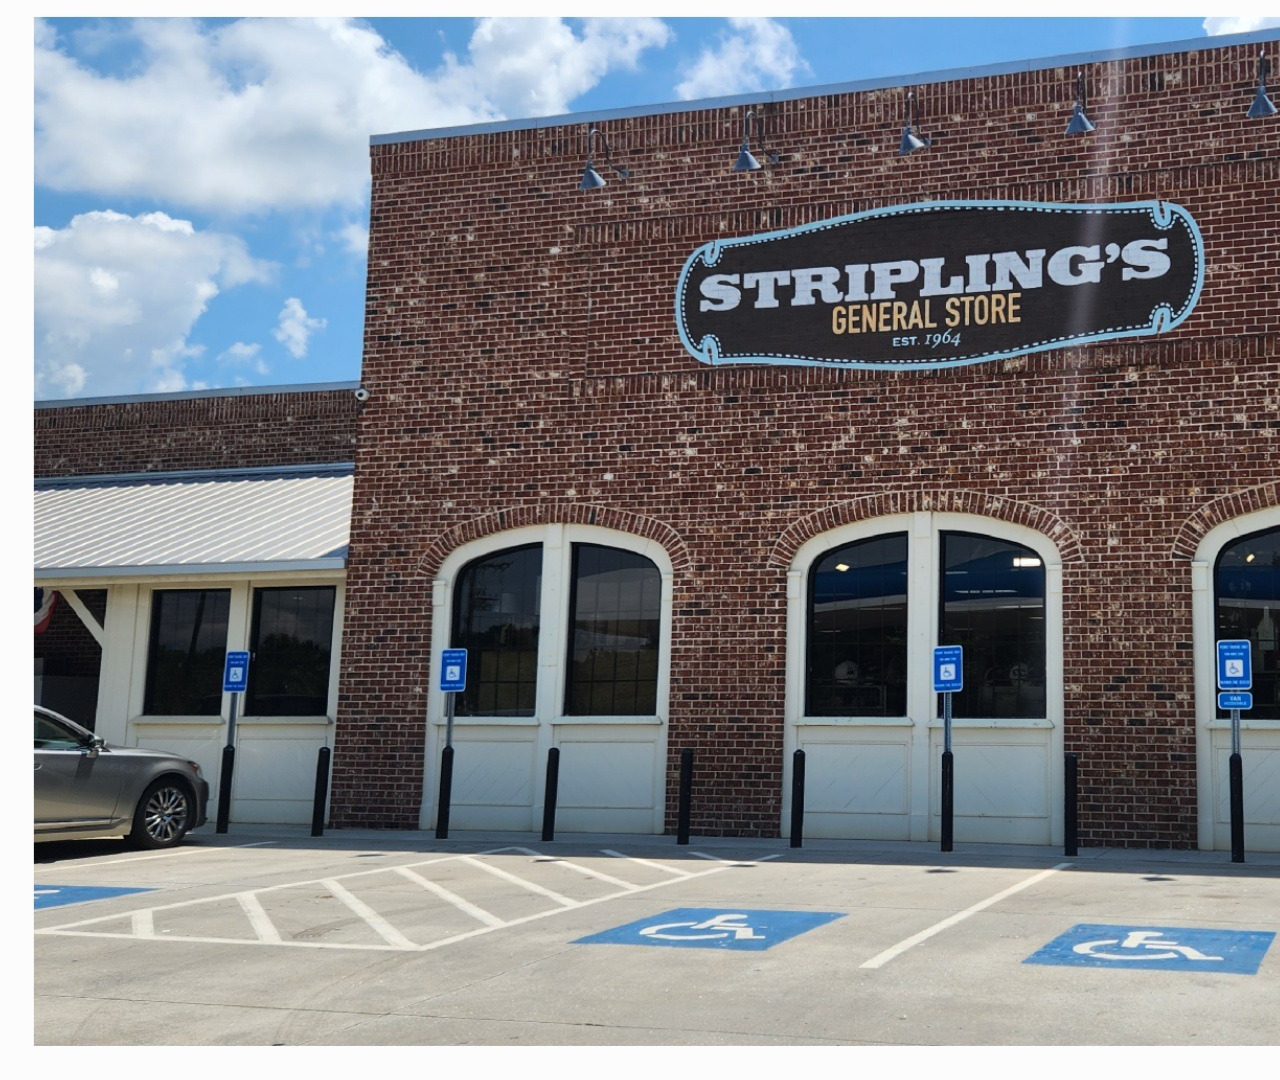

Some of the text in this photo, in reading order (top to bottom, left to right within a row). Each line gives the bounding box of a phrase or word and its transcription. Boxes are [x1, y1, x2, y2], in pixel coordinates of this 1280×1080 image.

[699, 237, 1172, 313] STRIPLING'S
[832, 292, 1022, 335] GENERAL STORE
[892, 329, 962, 349] EST. 1964
